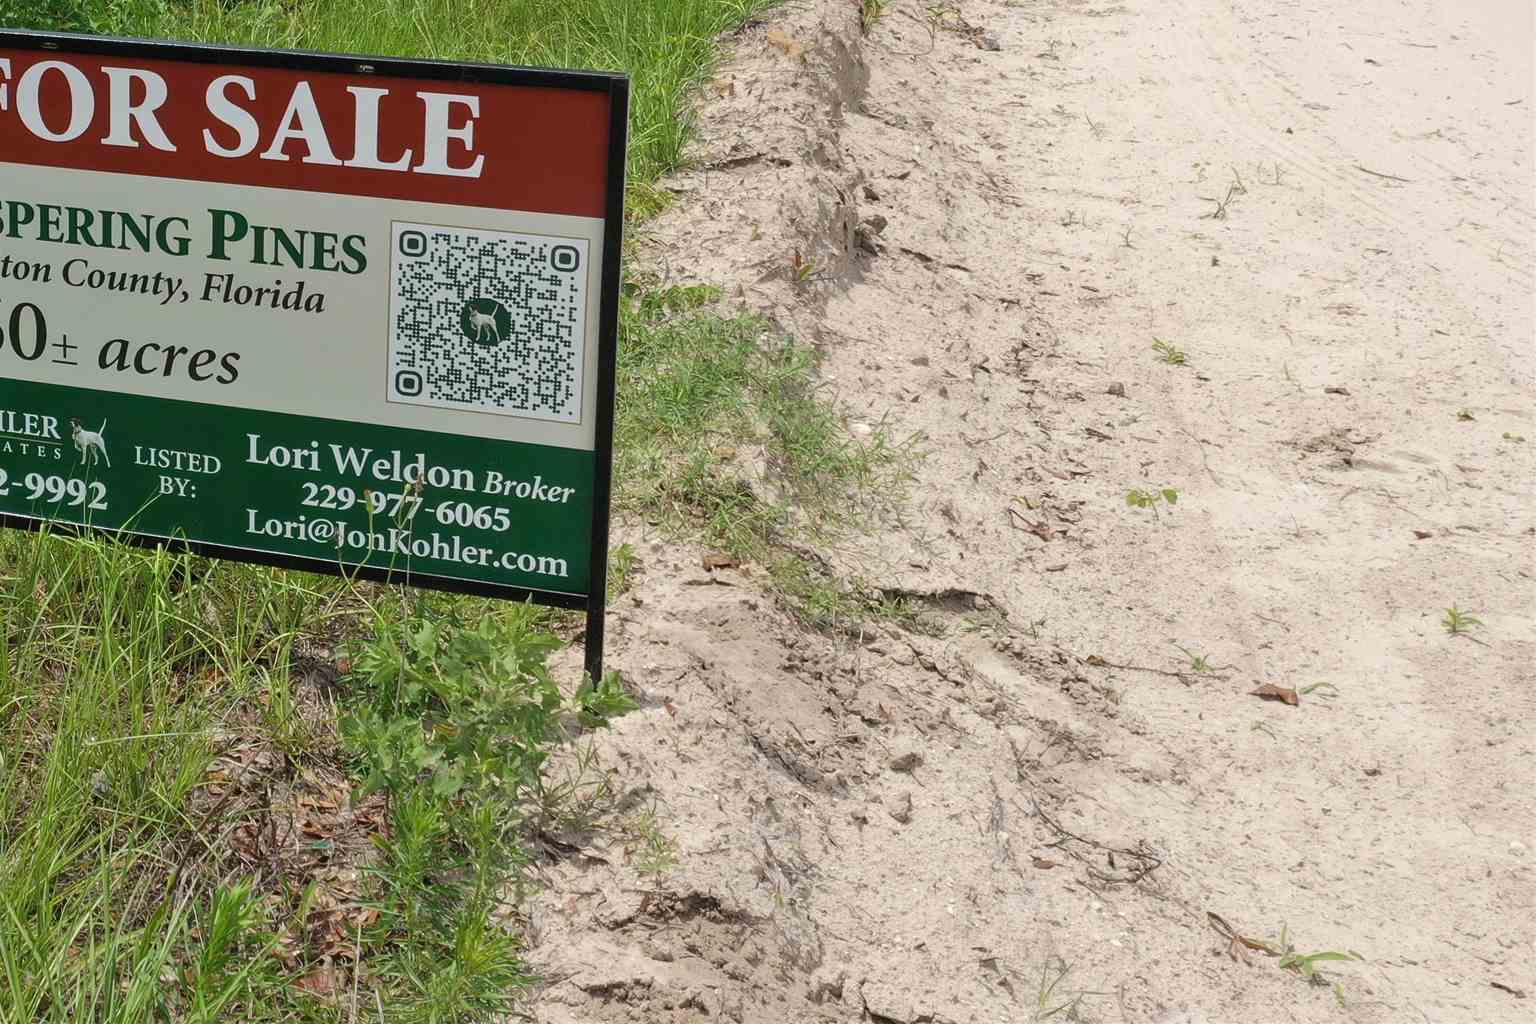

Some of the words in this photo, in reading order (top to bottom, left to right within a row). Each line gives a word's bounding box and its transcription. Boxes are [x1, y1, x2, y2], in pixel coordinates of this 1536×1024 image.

[202, 74, 485, 179] SALE
[62, 257, 189, 305] County,
[200, 272, 326, 314] Florida
[98, 338, 241, 385] acres
[134, 446, 222, 475] LISTED
[158, 475, 197, 499] BY:
[246, 433, 321, 472] Lori
[329, 443, 475, 492] Weldon
[482, 470, 576, 505] Broker
[301, 481, 512, 532] 229-977-6065
[246, 508, 569, 578] Lori@JonKohler.com
